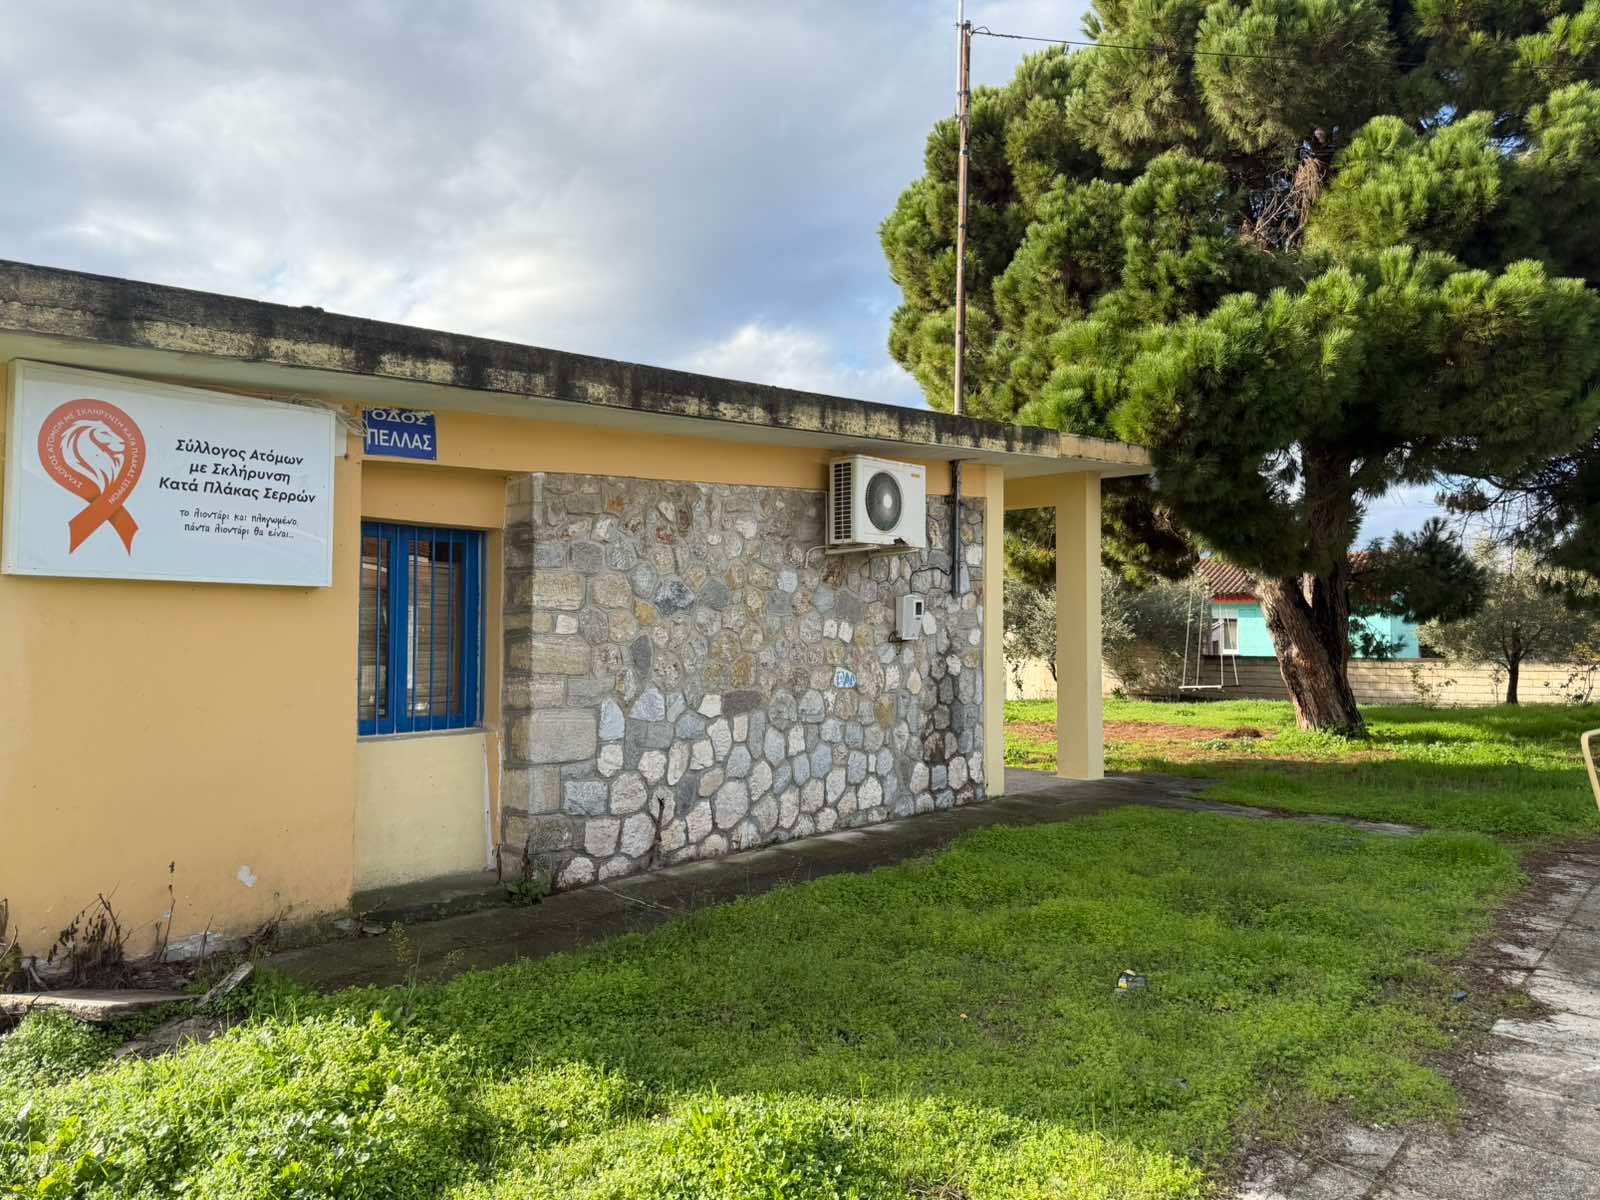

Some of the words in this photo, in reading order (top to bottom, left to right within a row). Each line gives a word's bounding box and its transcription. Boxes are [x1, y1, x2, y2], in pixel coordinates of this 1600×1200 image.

[371, 409, 427, 426] ΟΔΟΣ
[367, 428, 432, 451] ΠΕΛΛΑΣ
[176, 439, 246, 461] Σύλλογος
[250, 449, 304, 465] Ατόμων
[189, 463, 208, 474] με
[212, 463, 291, 485] Σκλήρυνση
[159, 477, 198, 492] Κατά
[203, 481, 260, 500] Πλάκας
[263, 488, 316, 503] Σερρών
[180, 509, 190, 517] το
[194, 508, 230, 525] λιοντάρι
[251, 513, 297, 528] πληγωμένο
[184, 522, 210, 532] πάντα
[214, 523, 249, 540] λιοντάρι
[253, 526, 264, 536] θα
